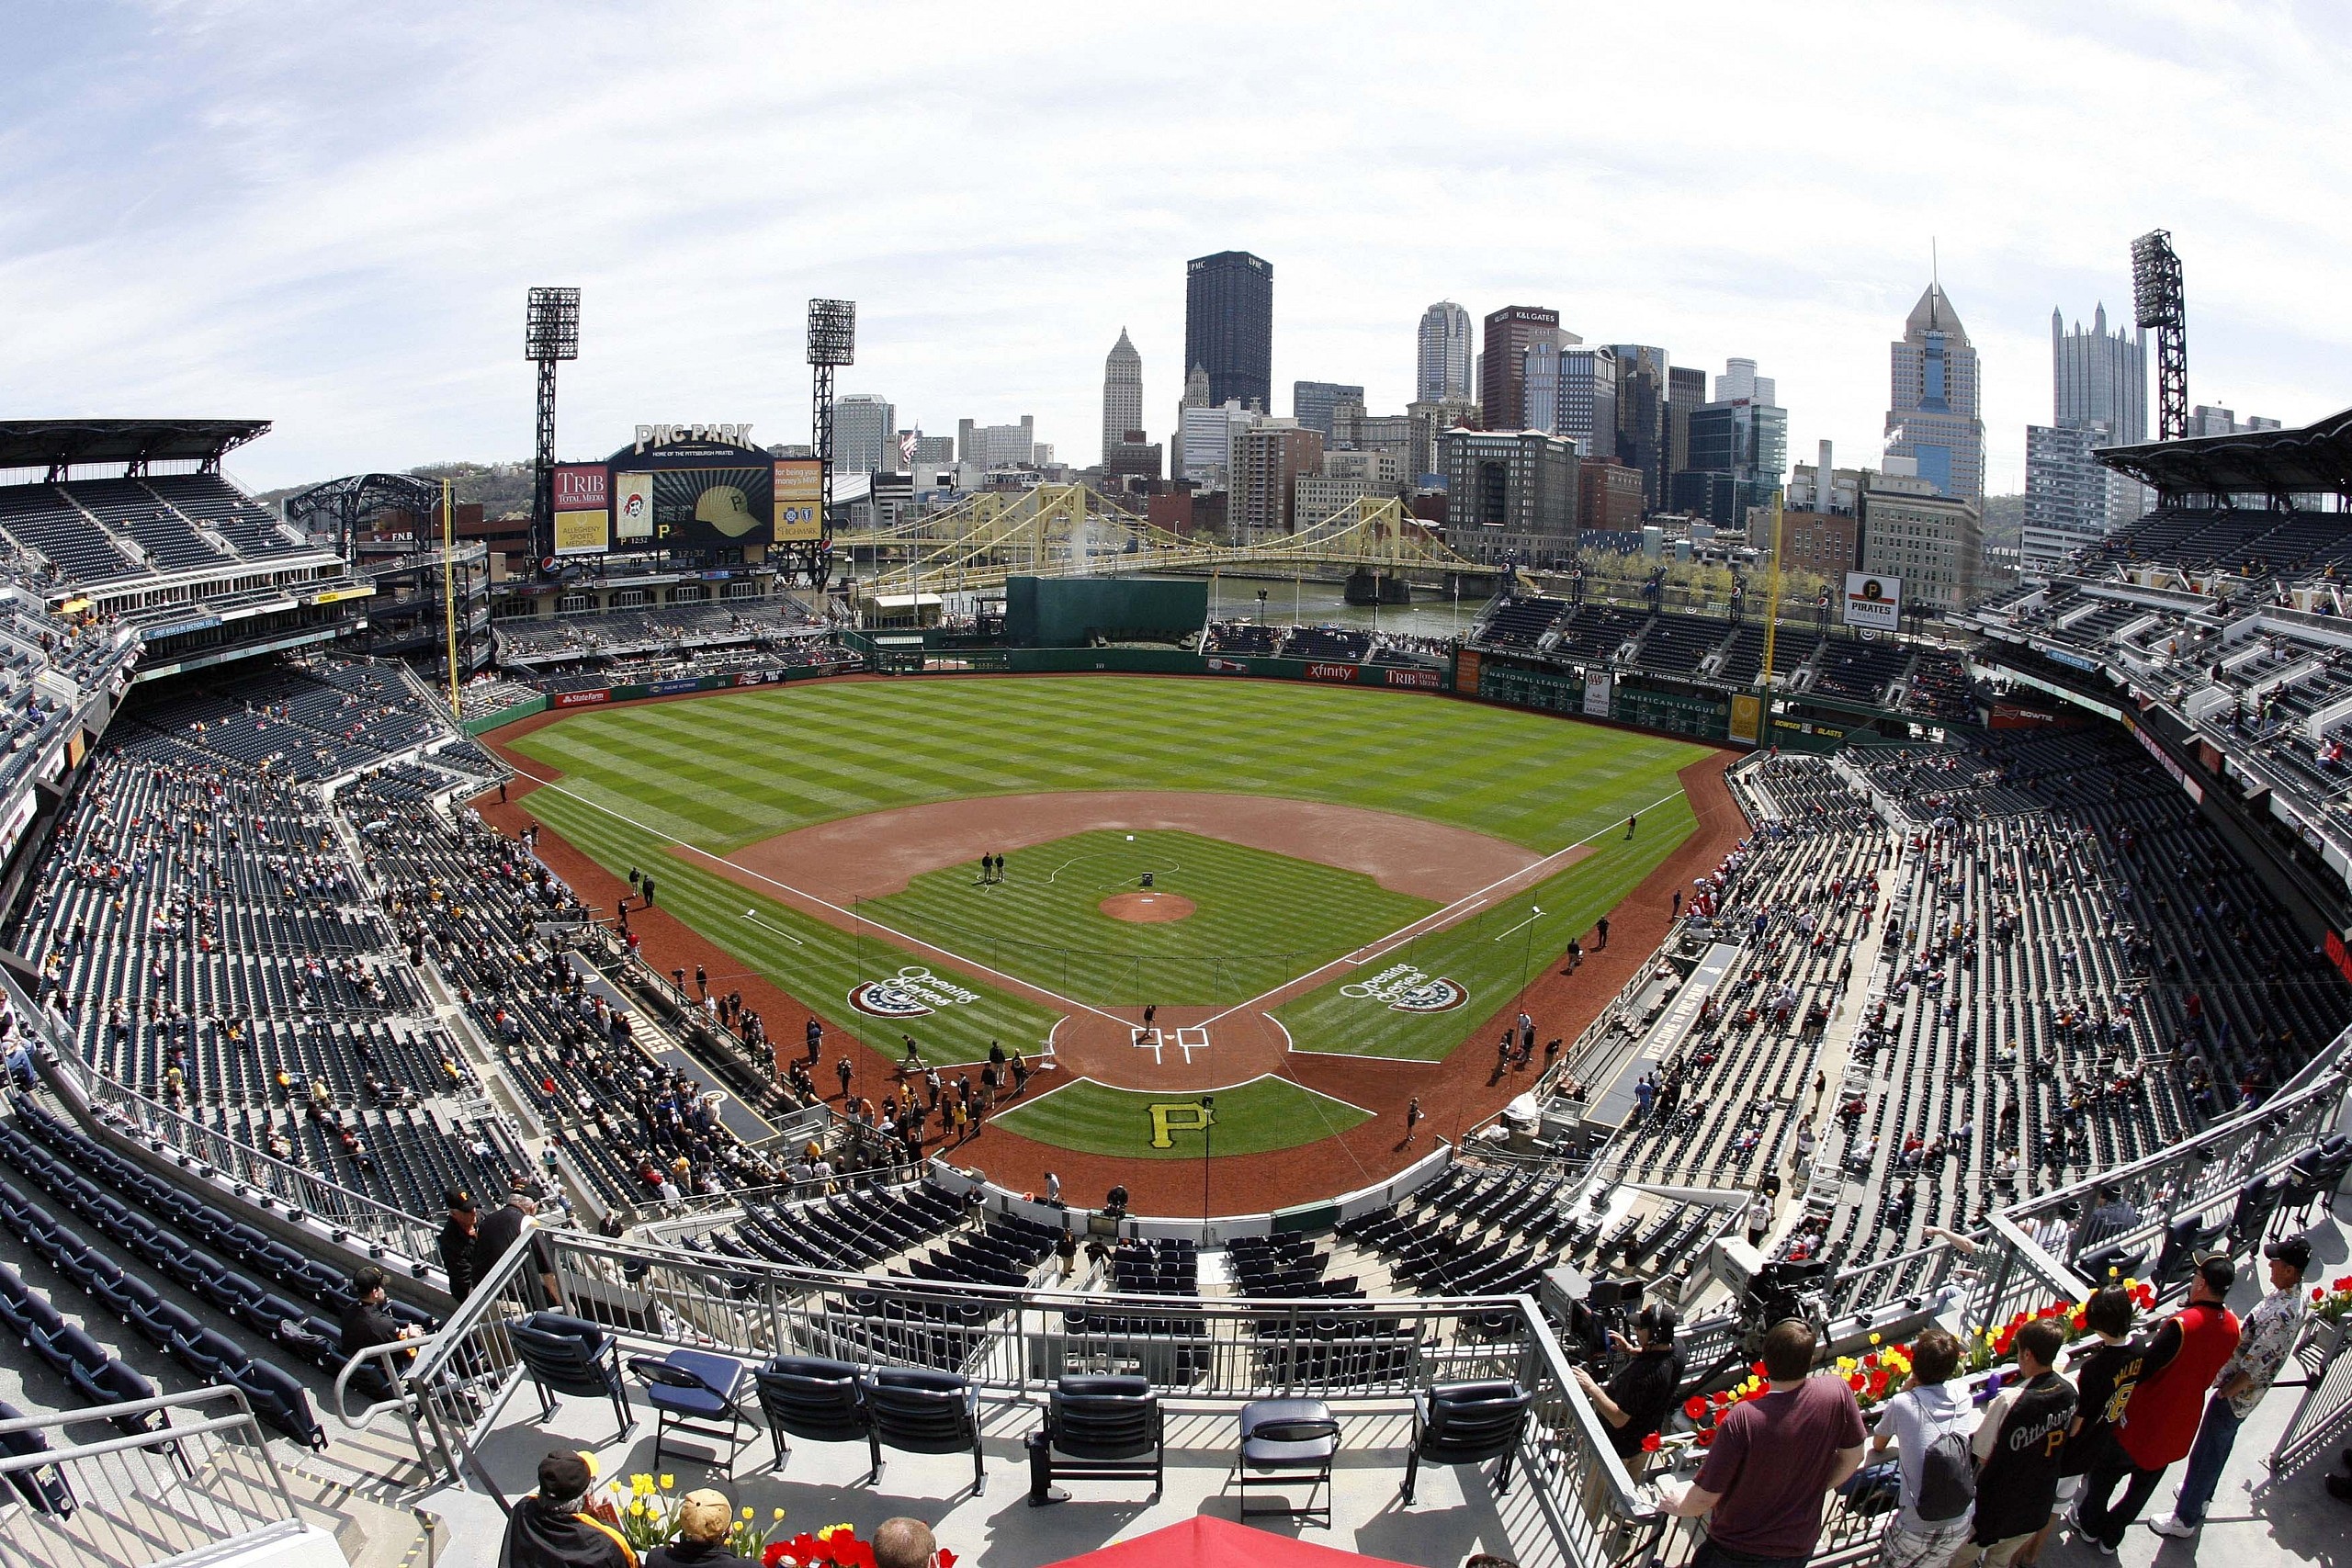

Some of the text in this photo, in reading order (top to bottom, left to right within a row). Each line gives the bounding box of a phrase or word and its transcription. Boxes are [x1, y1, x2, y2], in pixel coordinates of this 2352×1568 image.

[1516, 311, 1555, 322] K&L GATES
[635, 424, 755, 455] PNC PARK
[775, 477, 801, 486] money's
[786, 468, 803, 477] being
[557, 473, 604, 494] TRIB
[558, 493, 605, 503] TOTAL MEDIA
[1851, 610, 1891, 622] CHARITIES
[1852, 602, 1891, 615] PIRATES
[1464, 645, 1491, 654] CONNECT
[1311, 664, 1353, 680] xfinity
[1385, 670, 1415, 685] TRIB
[1418, 673, 1439, 681] TOTAL
[1490, 671, 1571, 690] NATIONAL LEAGUE
[1623, 693, 1715, 715] AMERICAN LEAGUE
[2020, 711, 2053, 722] BOWTIE
[1774, 720, 1801, 730] BOWSER
[1818, 728, 1843, 738] BLASTS
[898, 966, 981, 1004] Opening
[1340, 963, 1418, 998] Opening
[1376, 972, 1428, 1003] Series
[881, 978, 953, 1006] Series
[1641, 982, 1709, 1060] WELCOME TO PNC PARK
[622, 1010, 674, 1054] PIRATES
[1146, 1100, 1216, 1149] P
[2044, 1429, 2065, 1457] P
